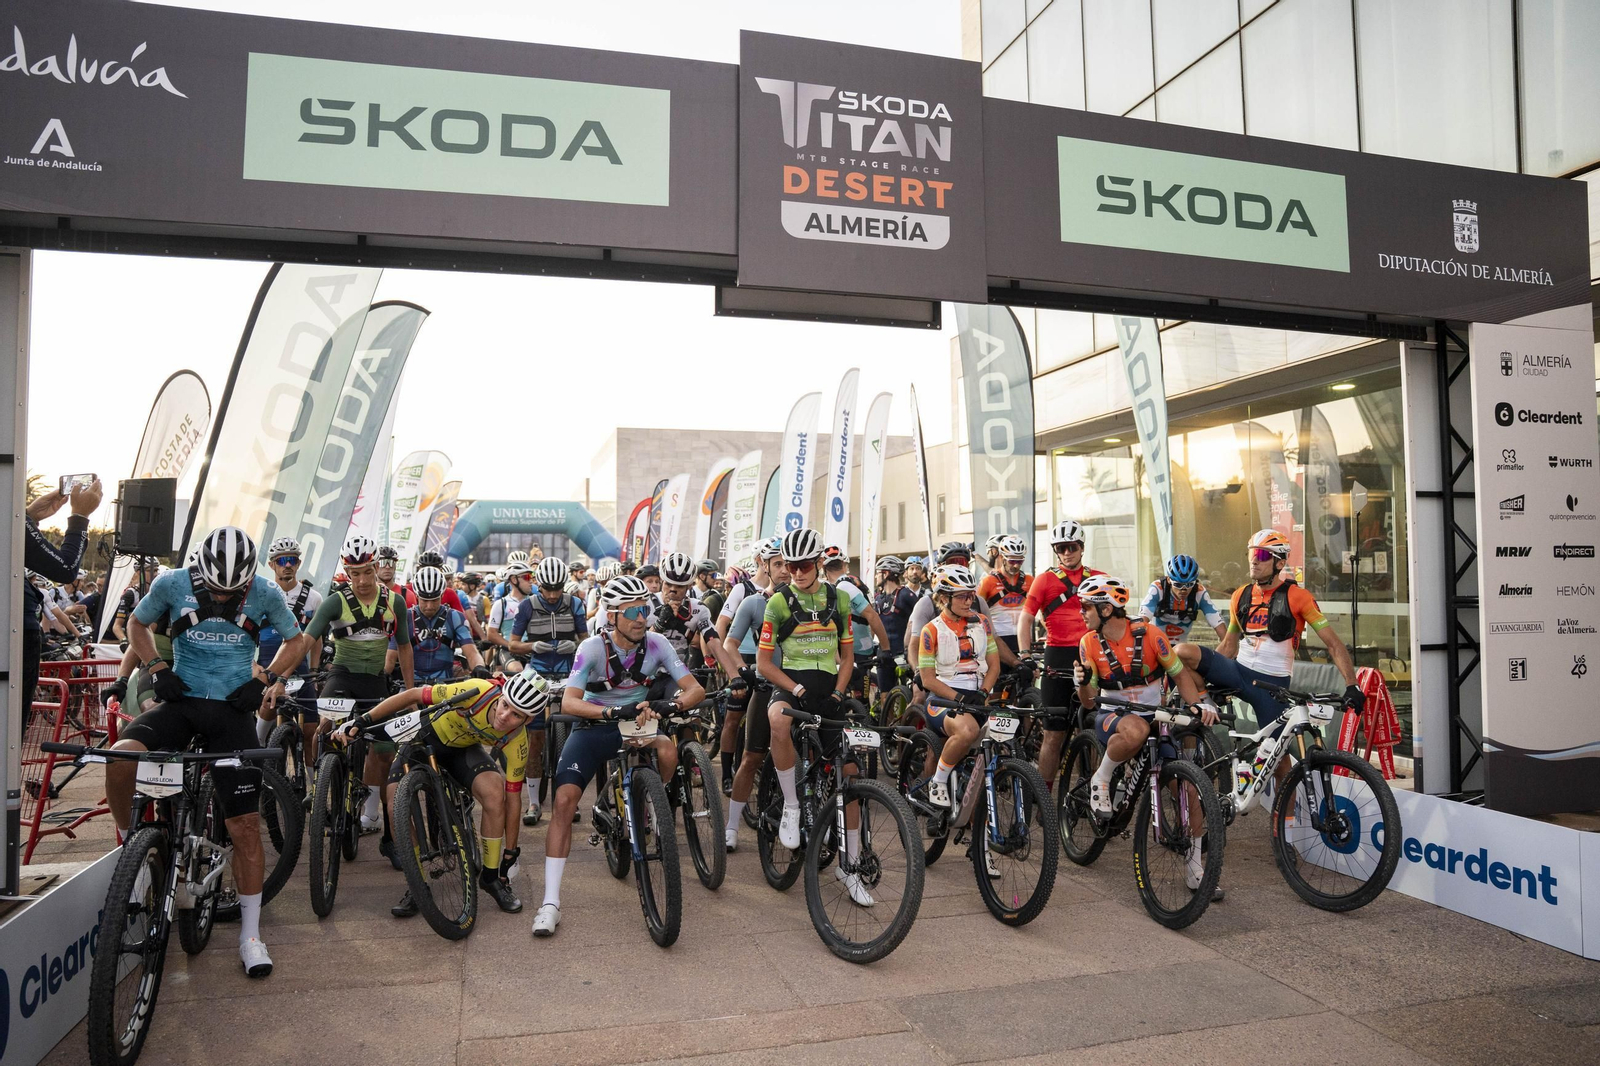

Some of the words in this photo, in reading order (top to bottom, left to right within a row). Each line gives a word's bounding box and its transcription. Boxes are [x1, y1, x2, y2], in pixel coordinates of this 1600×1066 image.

[754, 77, 951, 162] TITAN
[4, 156, 34, 166] Junta
[37, 158, 50, 168] de
[52, 160, 103, 172] Andalucía
[796, 153, 828, 163] MTB
[839, 157, 890, 170] STAGE
[900, 164, 940, 176] RACE
[783, 165, 954, 209] DESERT
[804, 212, 928, 243] ALMERÍA
[1378, 253, 1468, 277] DIPUTACIÓN
[1471, 264, 1490, 280] DE
[1493, 266, 1554, 286] ALMERÍA
[1522, 354, 1572, 369] ALMERÍA
[1522, 368, 1549, 377] CIUDAD
[1517, 409, 1583, 425] Cleardent
[836, 408, 850, 493] Cleardent
[792, 432, 807, 508] Cleardent
[1496, 463, 1525, 472] primaflor
[1559, 457, 1593, 468] WÜRTH
[492, 508, 567, 519] UNIVERSAE
[1495, 546, 1533, 558] MRW
[1555, 548, 1594, 556] FINDIRECT
[1498, 583, 1533, 596] Almería
[796, 635, 831, 645] ecopilas
[1511, 659, 1519, 679] RAC
[1518, 659, 1526, 679] 1
[327, 699, 344, 707] 101
[1318, 704, 1325, 714] 2
[393, 714, 413, 730] 483
[995, 717, 1012, 728] 203
[1169, 714, 1176, 724] 4
[854, 730, 873, 739] 202
[157, 764, 164, 777] 1
[1253, 735, 1290, 798] ORBEA
[1307, 794, 1319, 815] FOX
[1371, 822, 1558, 906] Ceardent
